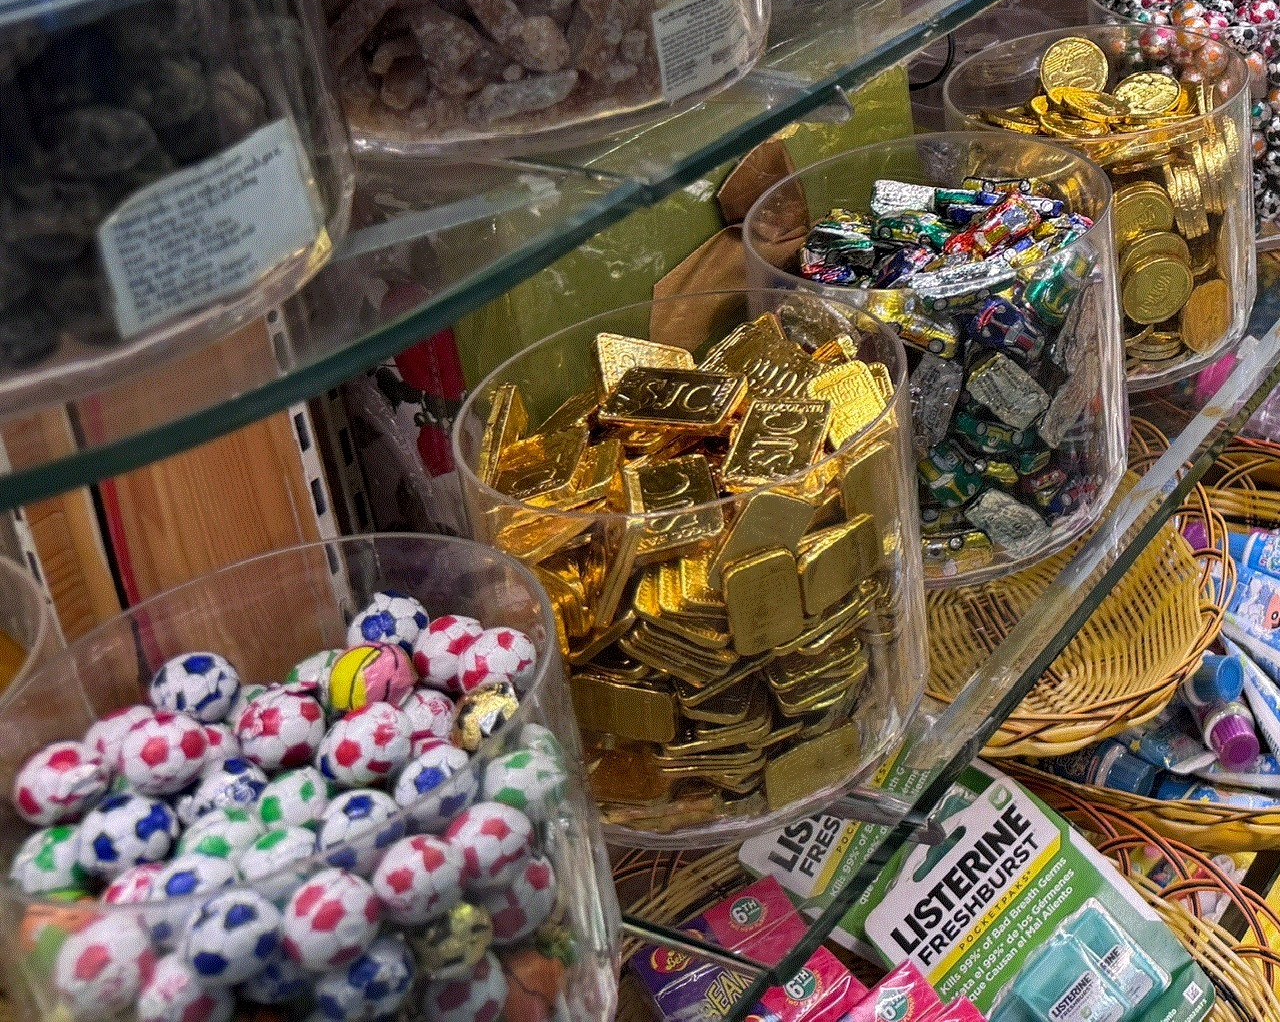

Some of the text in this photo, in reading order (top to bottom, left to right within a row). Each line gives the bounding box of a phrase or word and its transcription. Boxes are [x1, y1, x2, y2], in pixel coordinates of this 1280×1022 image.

[767, 814, 823, 873] LIS
[890, 803, 1031, 955] LISTERINE
[732, 899, 757, 925] 6TH
[917, 832, 1039, 967] FRESHBURST
[939, 971, 962, 995] Kills
[983, 937, 994, 952] of
[991, 916, 1012, 940] Bad
[1009, 887, 1040, 919] Breath
[1037, 857, 1067, 889] Germs
[968, 885, 1074, 1003] que Causan el Mal Aliento
[974, 965, 985, 979] el
[1006, 929, 1020, 944] de
[1016, 913, 1033, 932] los
[1031, 868, 1075, 915] Gérmenes
[784, 968, 809, 999] 6TH
[1051, 972, 1092, 1018] LISTERINE
